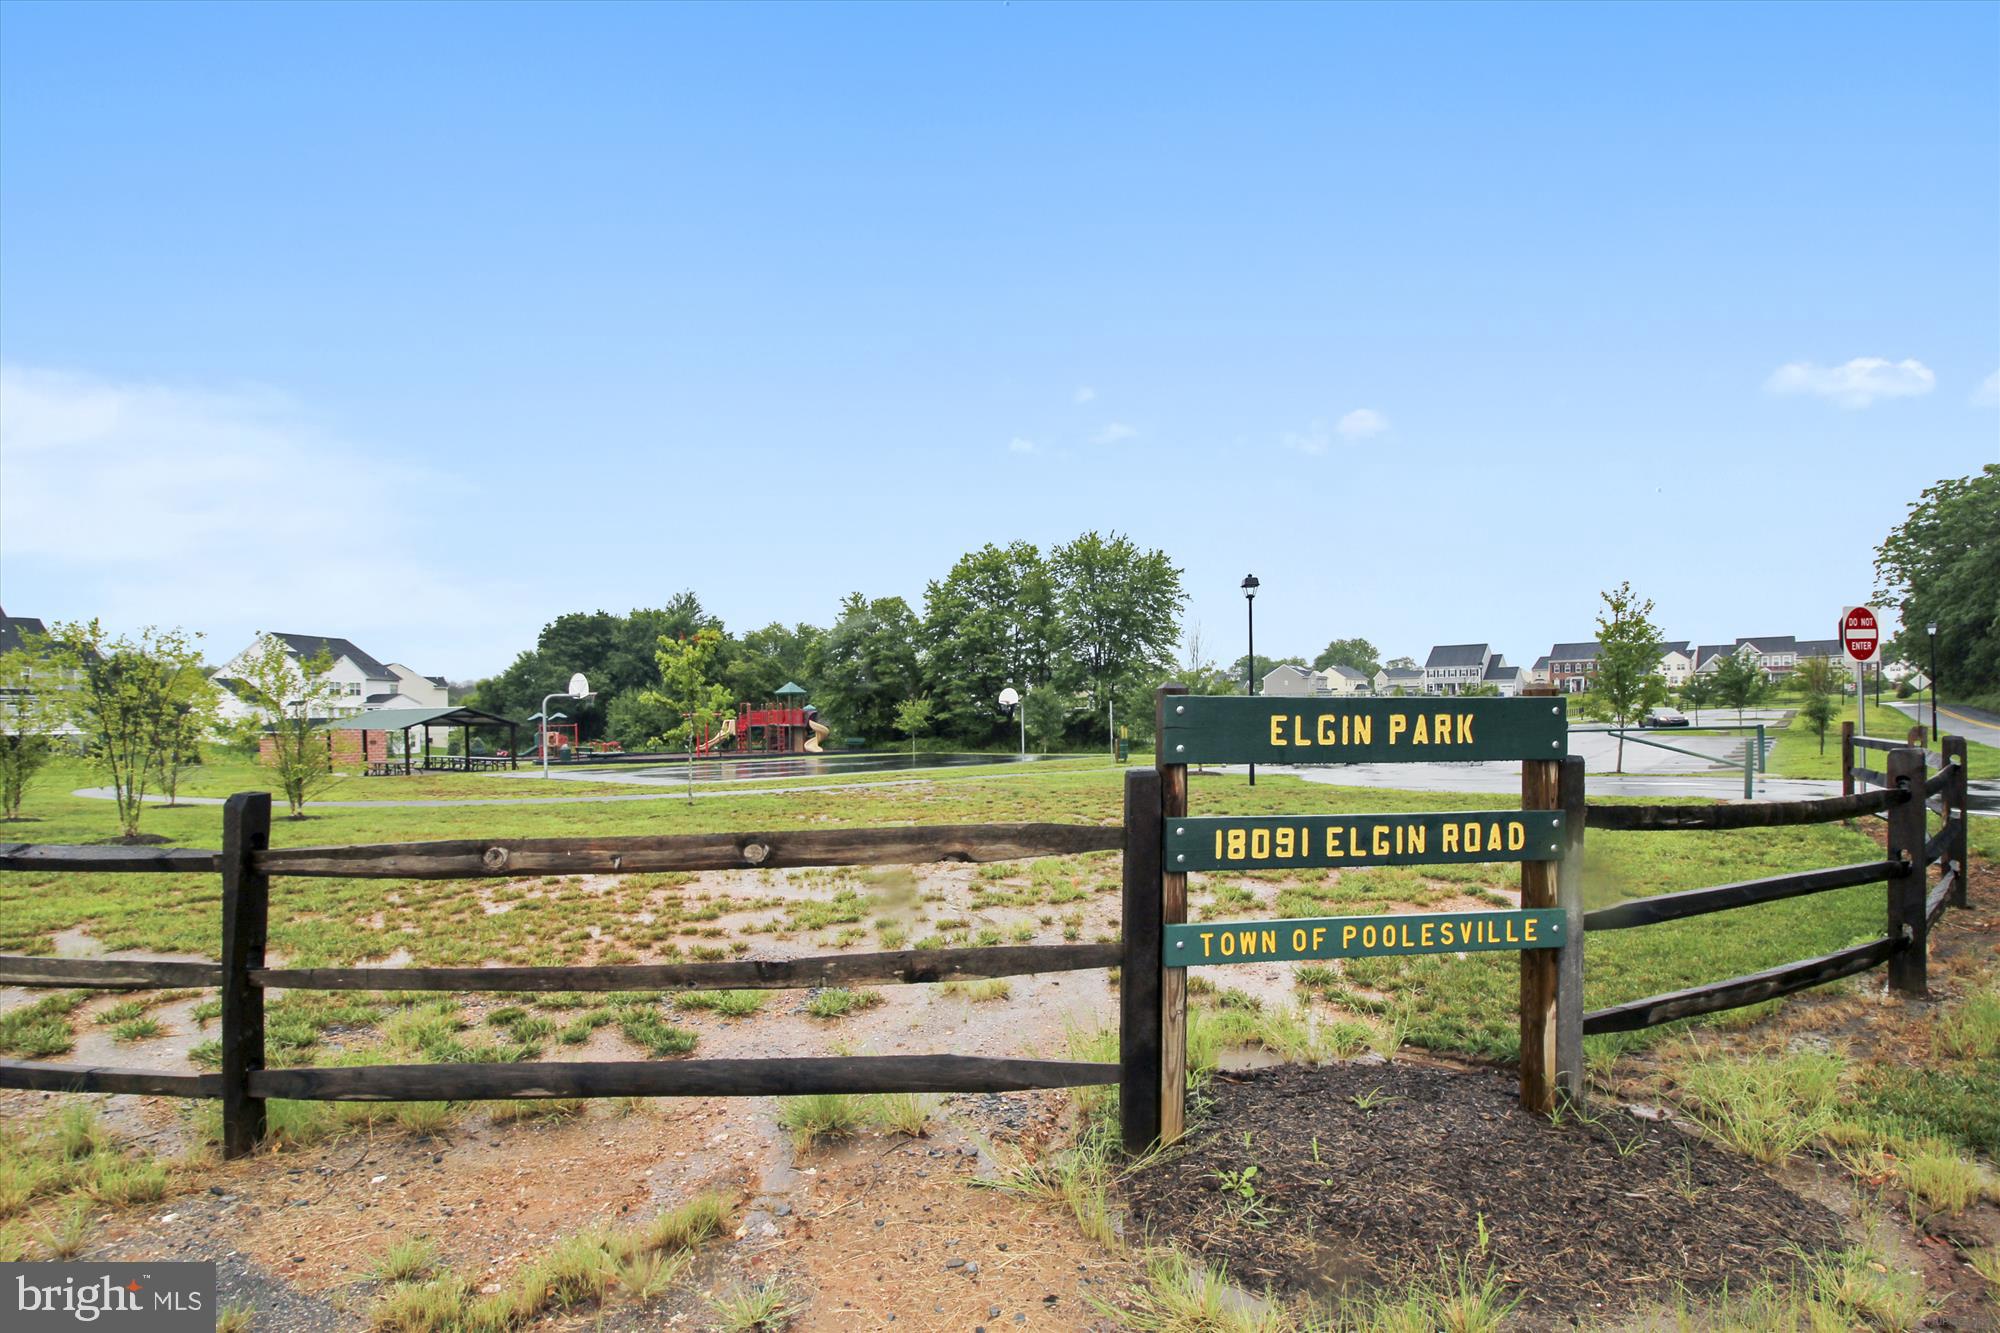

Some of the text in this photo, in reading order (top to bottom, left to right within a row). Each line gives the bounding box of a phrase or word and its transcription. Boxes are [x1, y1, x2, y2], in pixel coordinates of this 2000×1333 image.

[1848, 617, 1873, 627] DO NOT
[1851, 641, 1872, 651] ENTER
[1270, 713, 1473, 745] ELGIN PARK
[1215, 822, 1525, 859] 18091 ELGIN ROAD
[1200, 918, 1538, 956] TOWN OF POOLESVILLE
